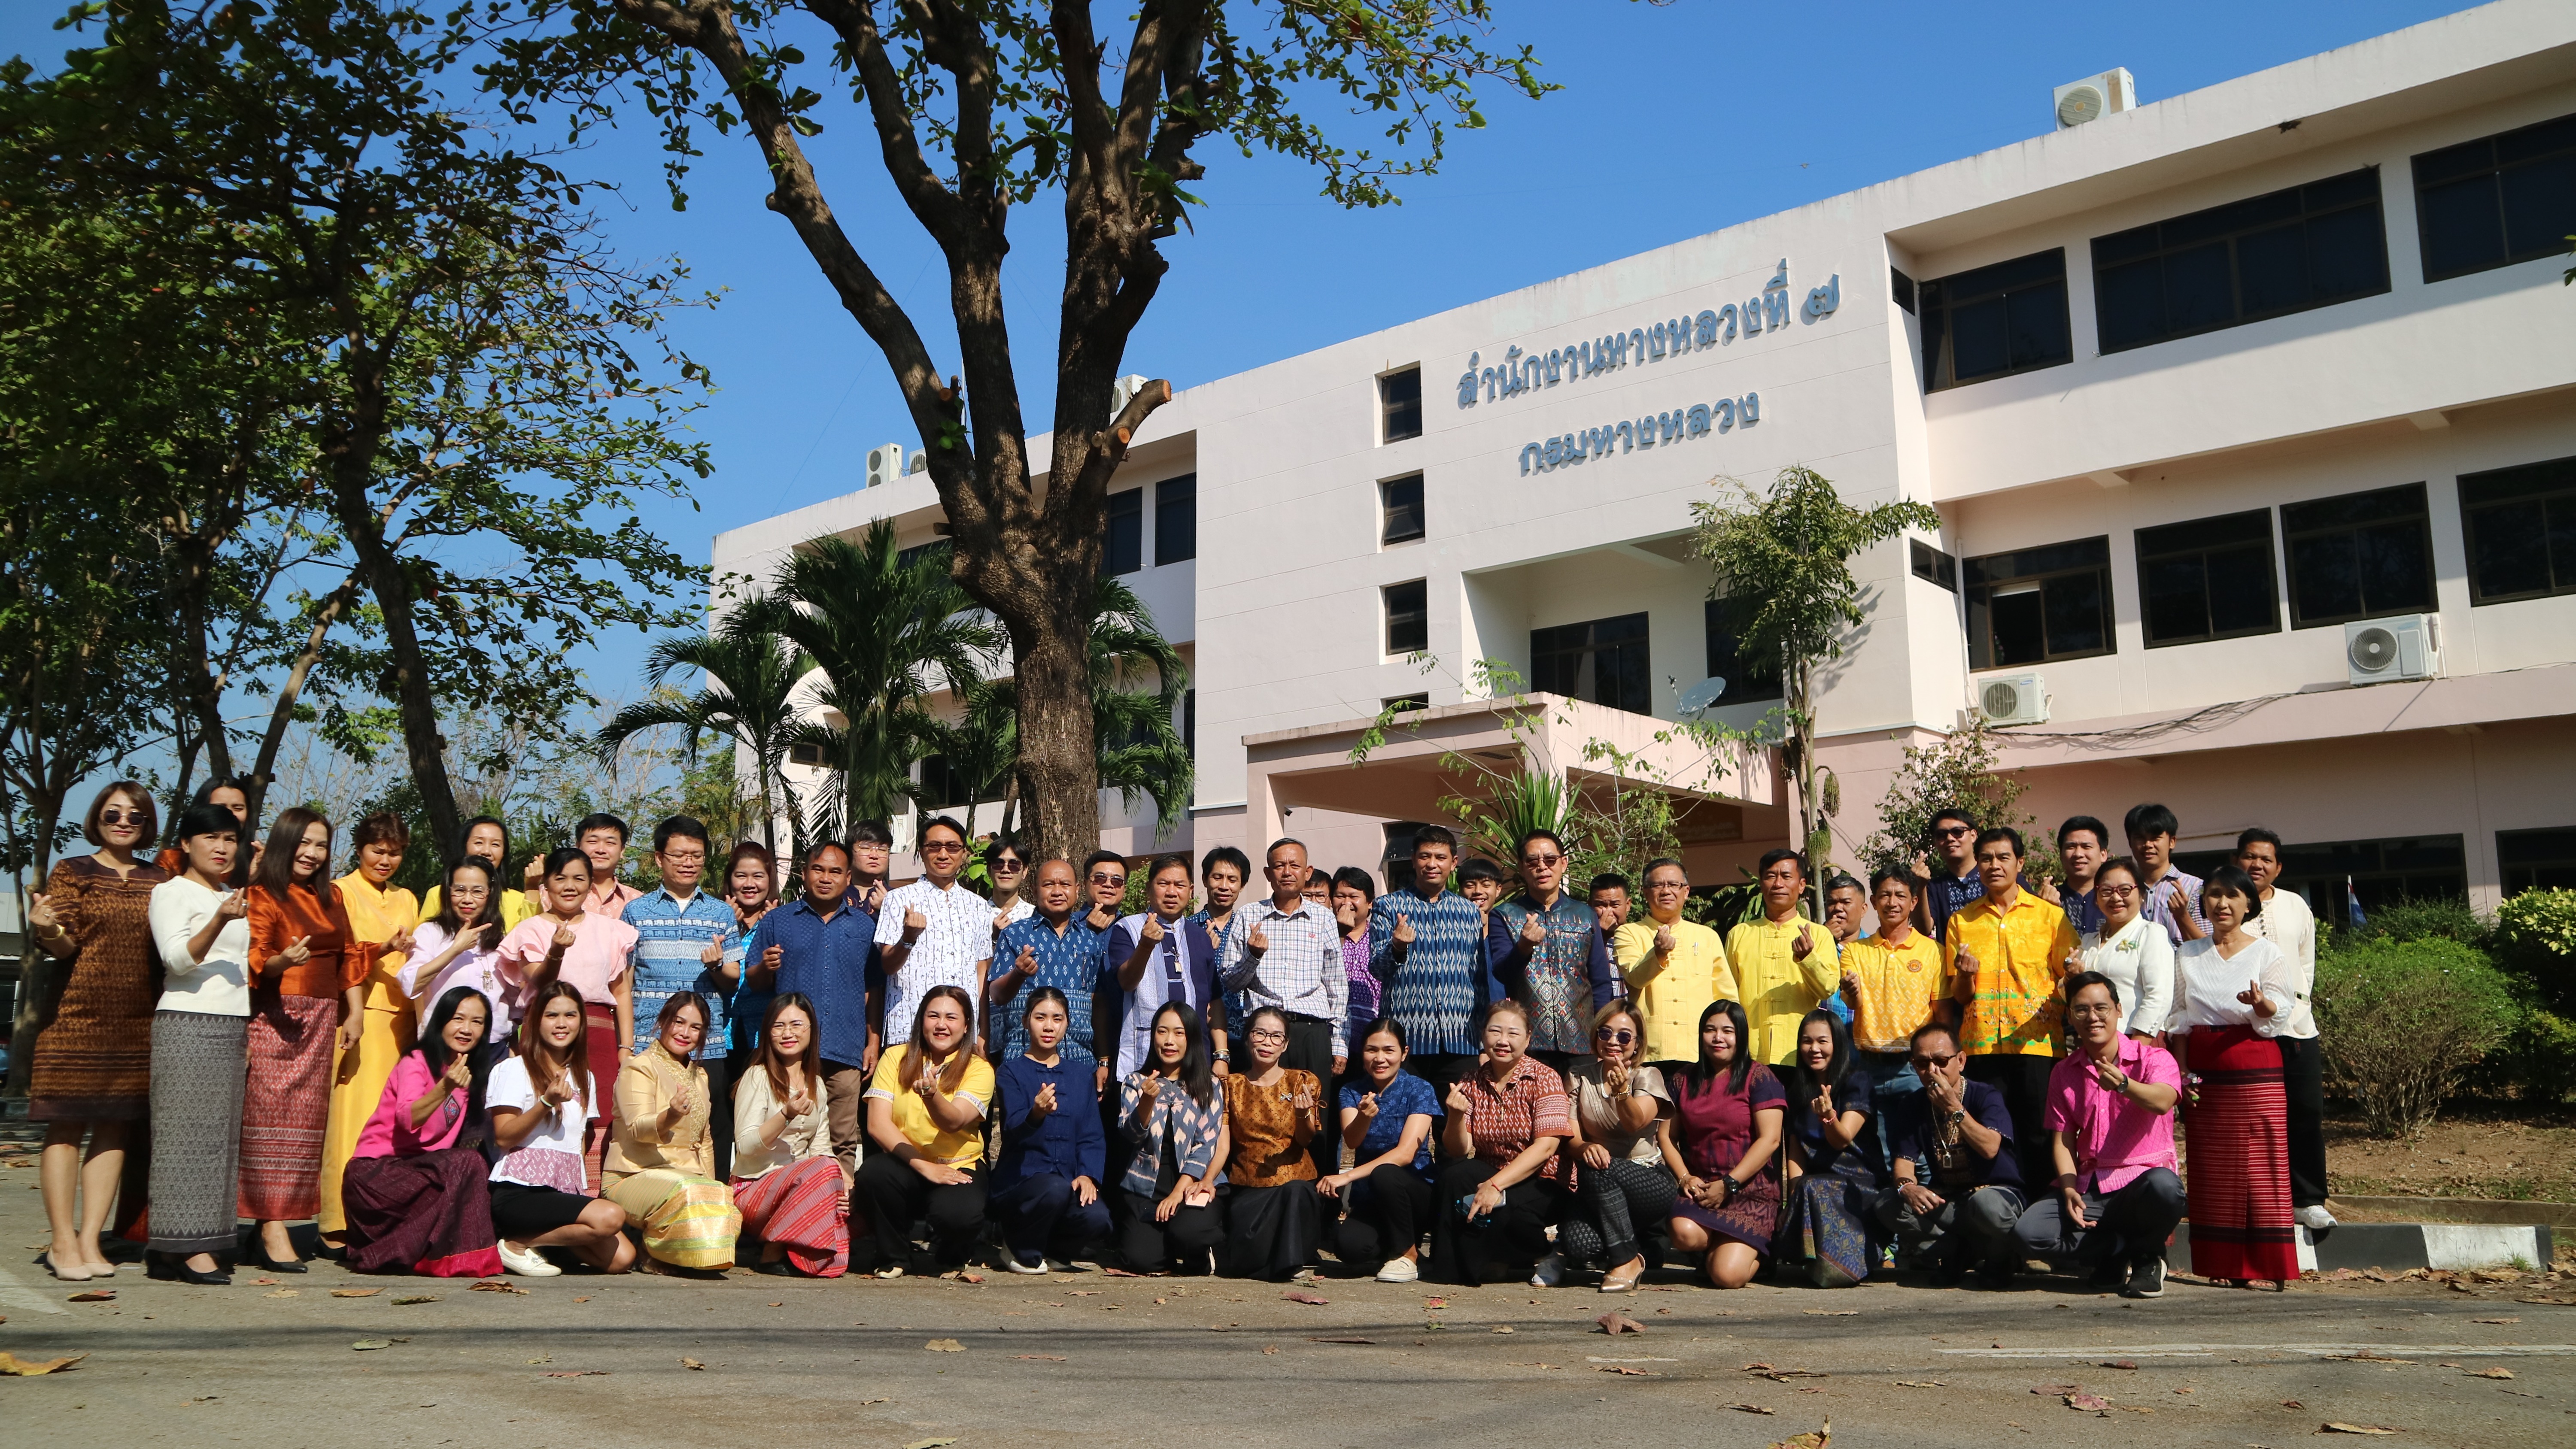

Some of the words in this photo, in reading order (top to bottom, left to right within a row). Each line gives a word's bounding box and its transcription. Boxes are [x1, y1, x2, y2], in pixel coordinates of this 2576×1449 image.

[1459, 258, 1791, 404] สำนักงานทางหลวงที่
[1807, 273, 1840, 316] ๗
[1522, 392, 1760, 470] กรมทางหลวง
